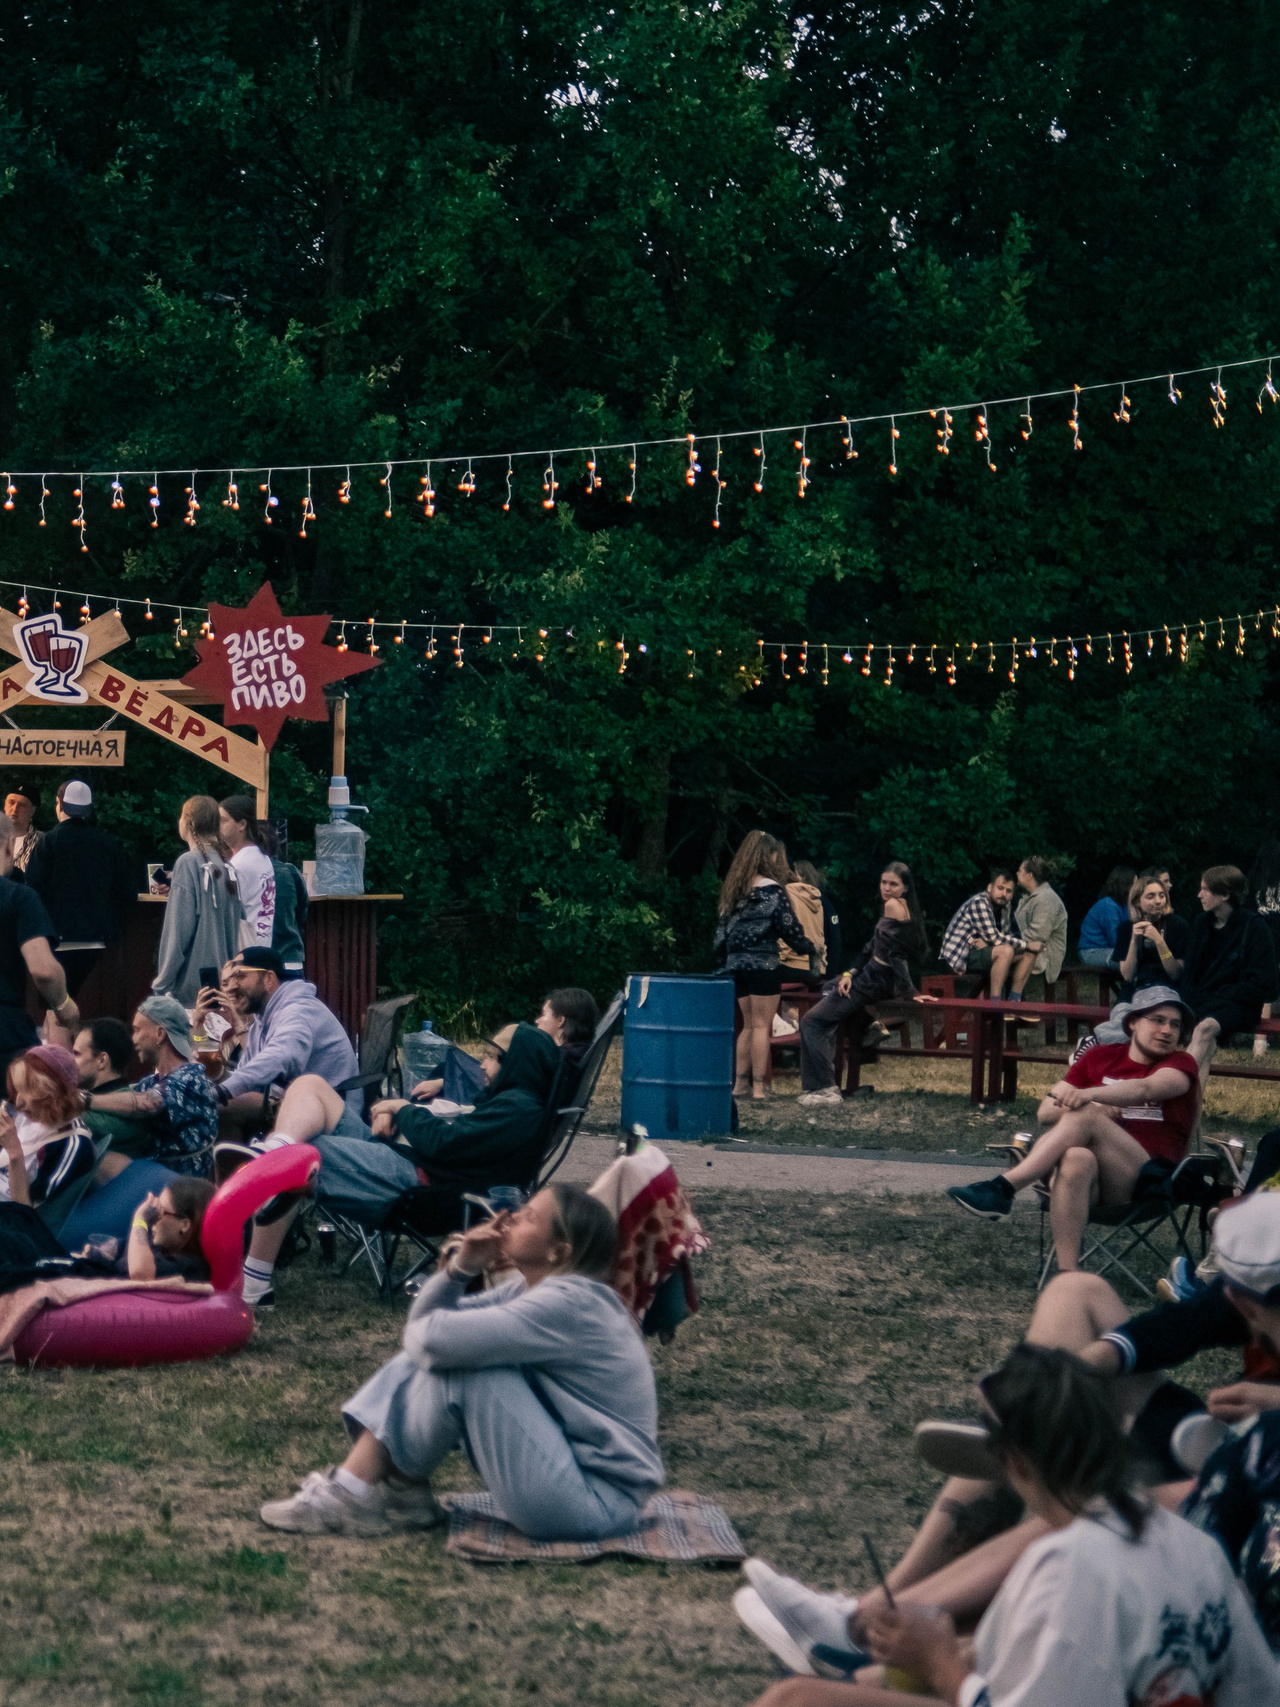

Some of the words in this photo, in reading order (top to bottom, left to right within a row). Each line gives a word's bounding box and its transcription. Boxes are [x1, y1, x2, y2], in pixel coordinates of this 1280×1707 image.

[223, 625, 305, 664] ЗДЕСЬ
[232, 652, 297, 686] ЕСТЬ
[231, 674, 306, 711] ПИВО
[99, 674, 229, 763] ВЁДРА
